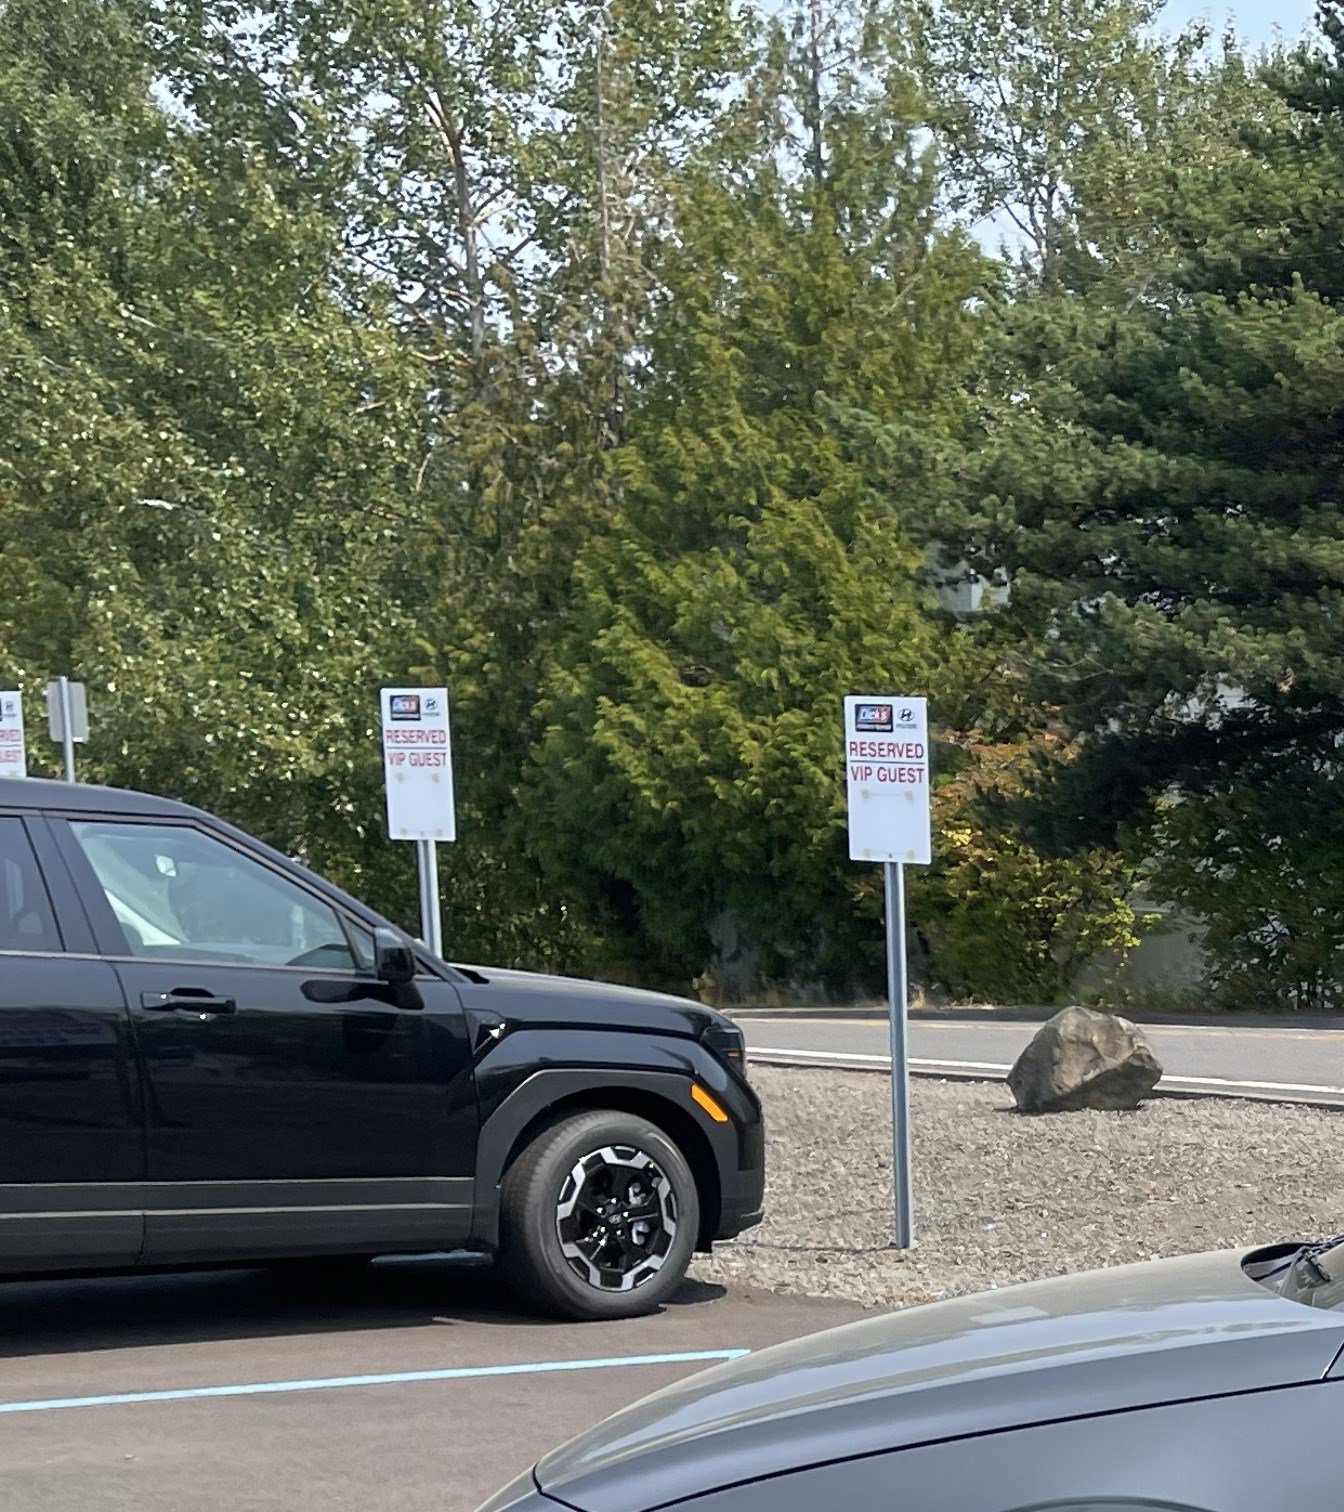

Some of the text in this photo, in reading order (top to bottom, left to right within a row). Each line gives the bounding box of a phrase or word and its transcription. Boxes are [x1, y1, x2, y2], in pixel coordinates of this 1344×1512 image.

[385, 729, 447, 744] RESERVED
[849, 741, 925, 759] RESERVED
[387, 752, 447, 767] VIP GUEST
[850, 766, 925, 784] VIP GUEST
